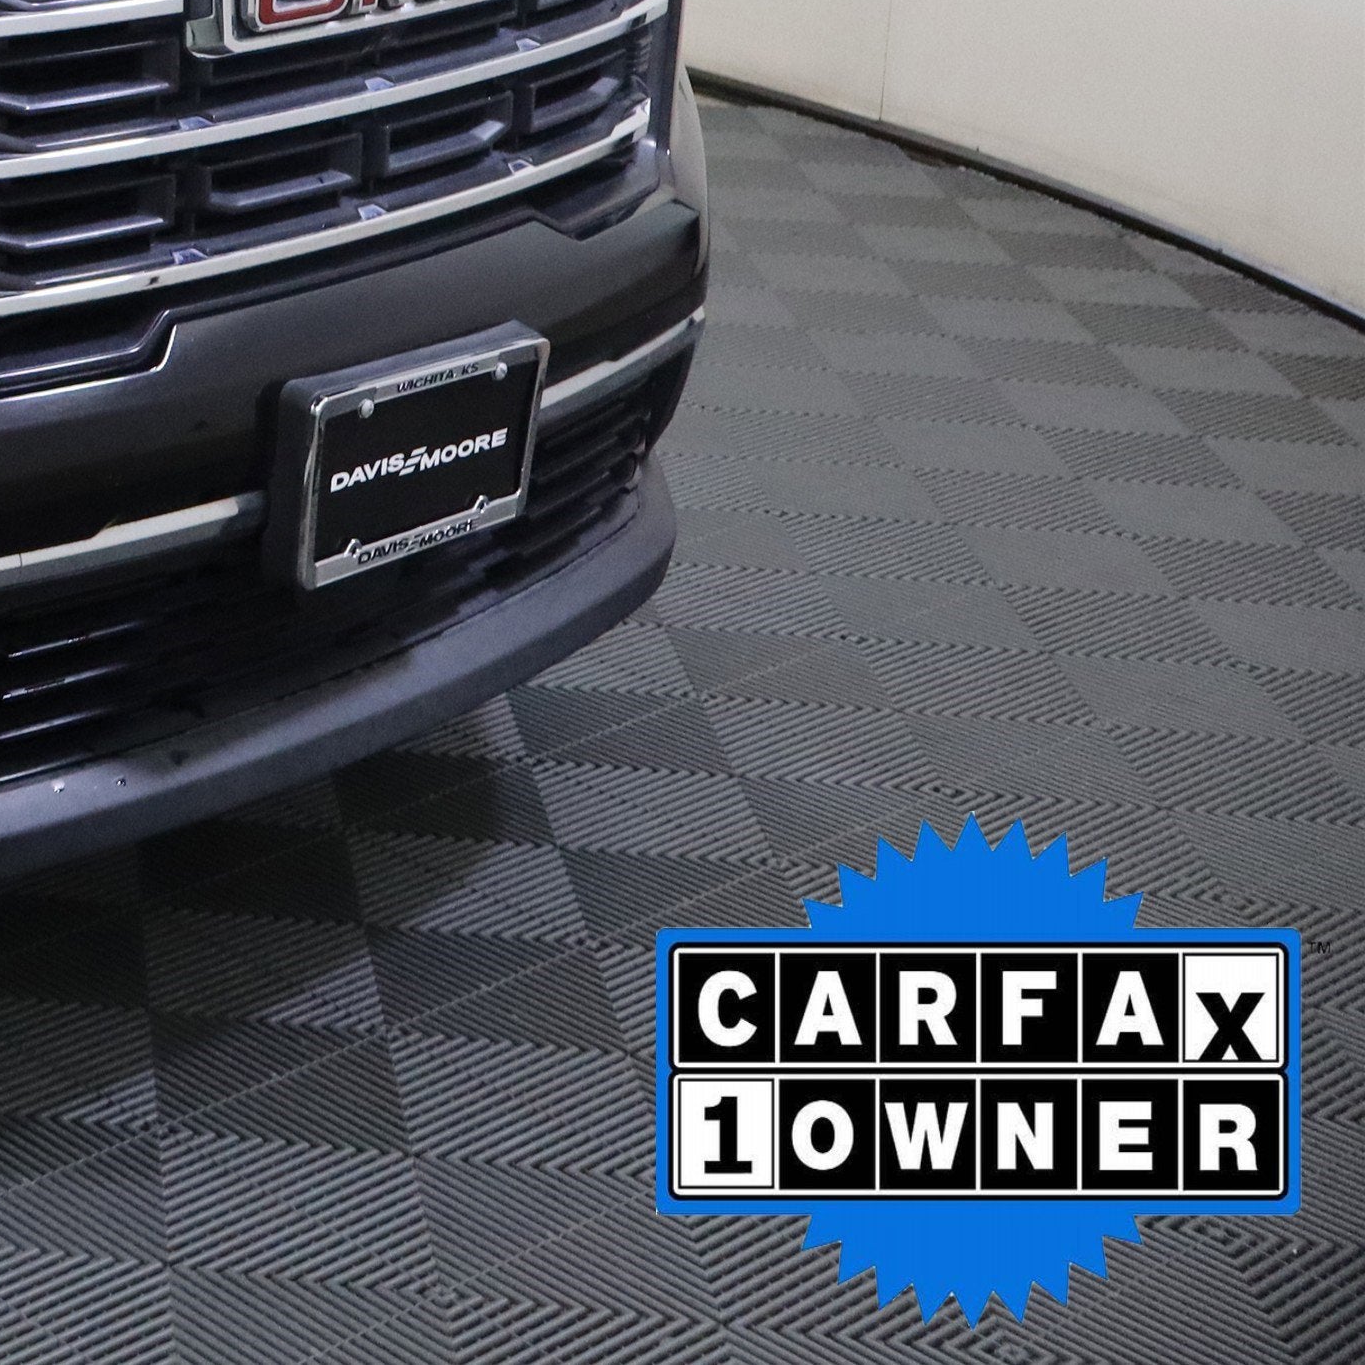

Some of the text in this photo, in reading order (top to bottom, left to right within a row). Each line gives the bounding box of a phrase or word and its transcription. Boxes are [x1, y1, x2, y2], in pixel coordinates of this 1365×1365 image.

[461, 363, 480, 376] KS
[330, 428, 509, 493] DAVIS MOORE
[357, 518, 481, 566] DAVIS MOORE
